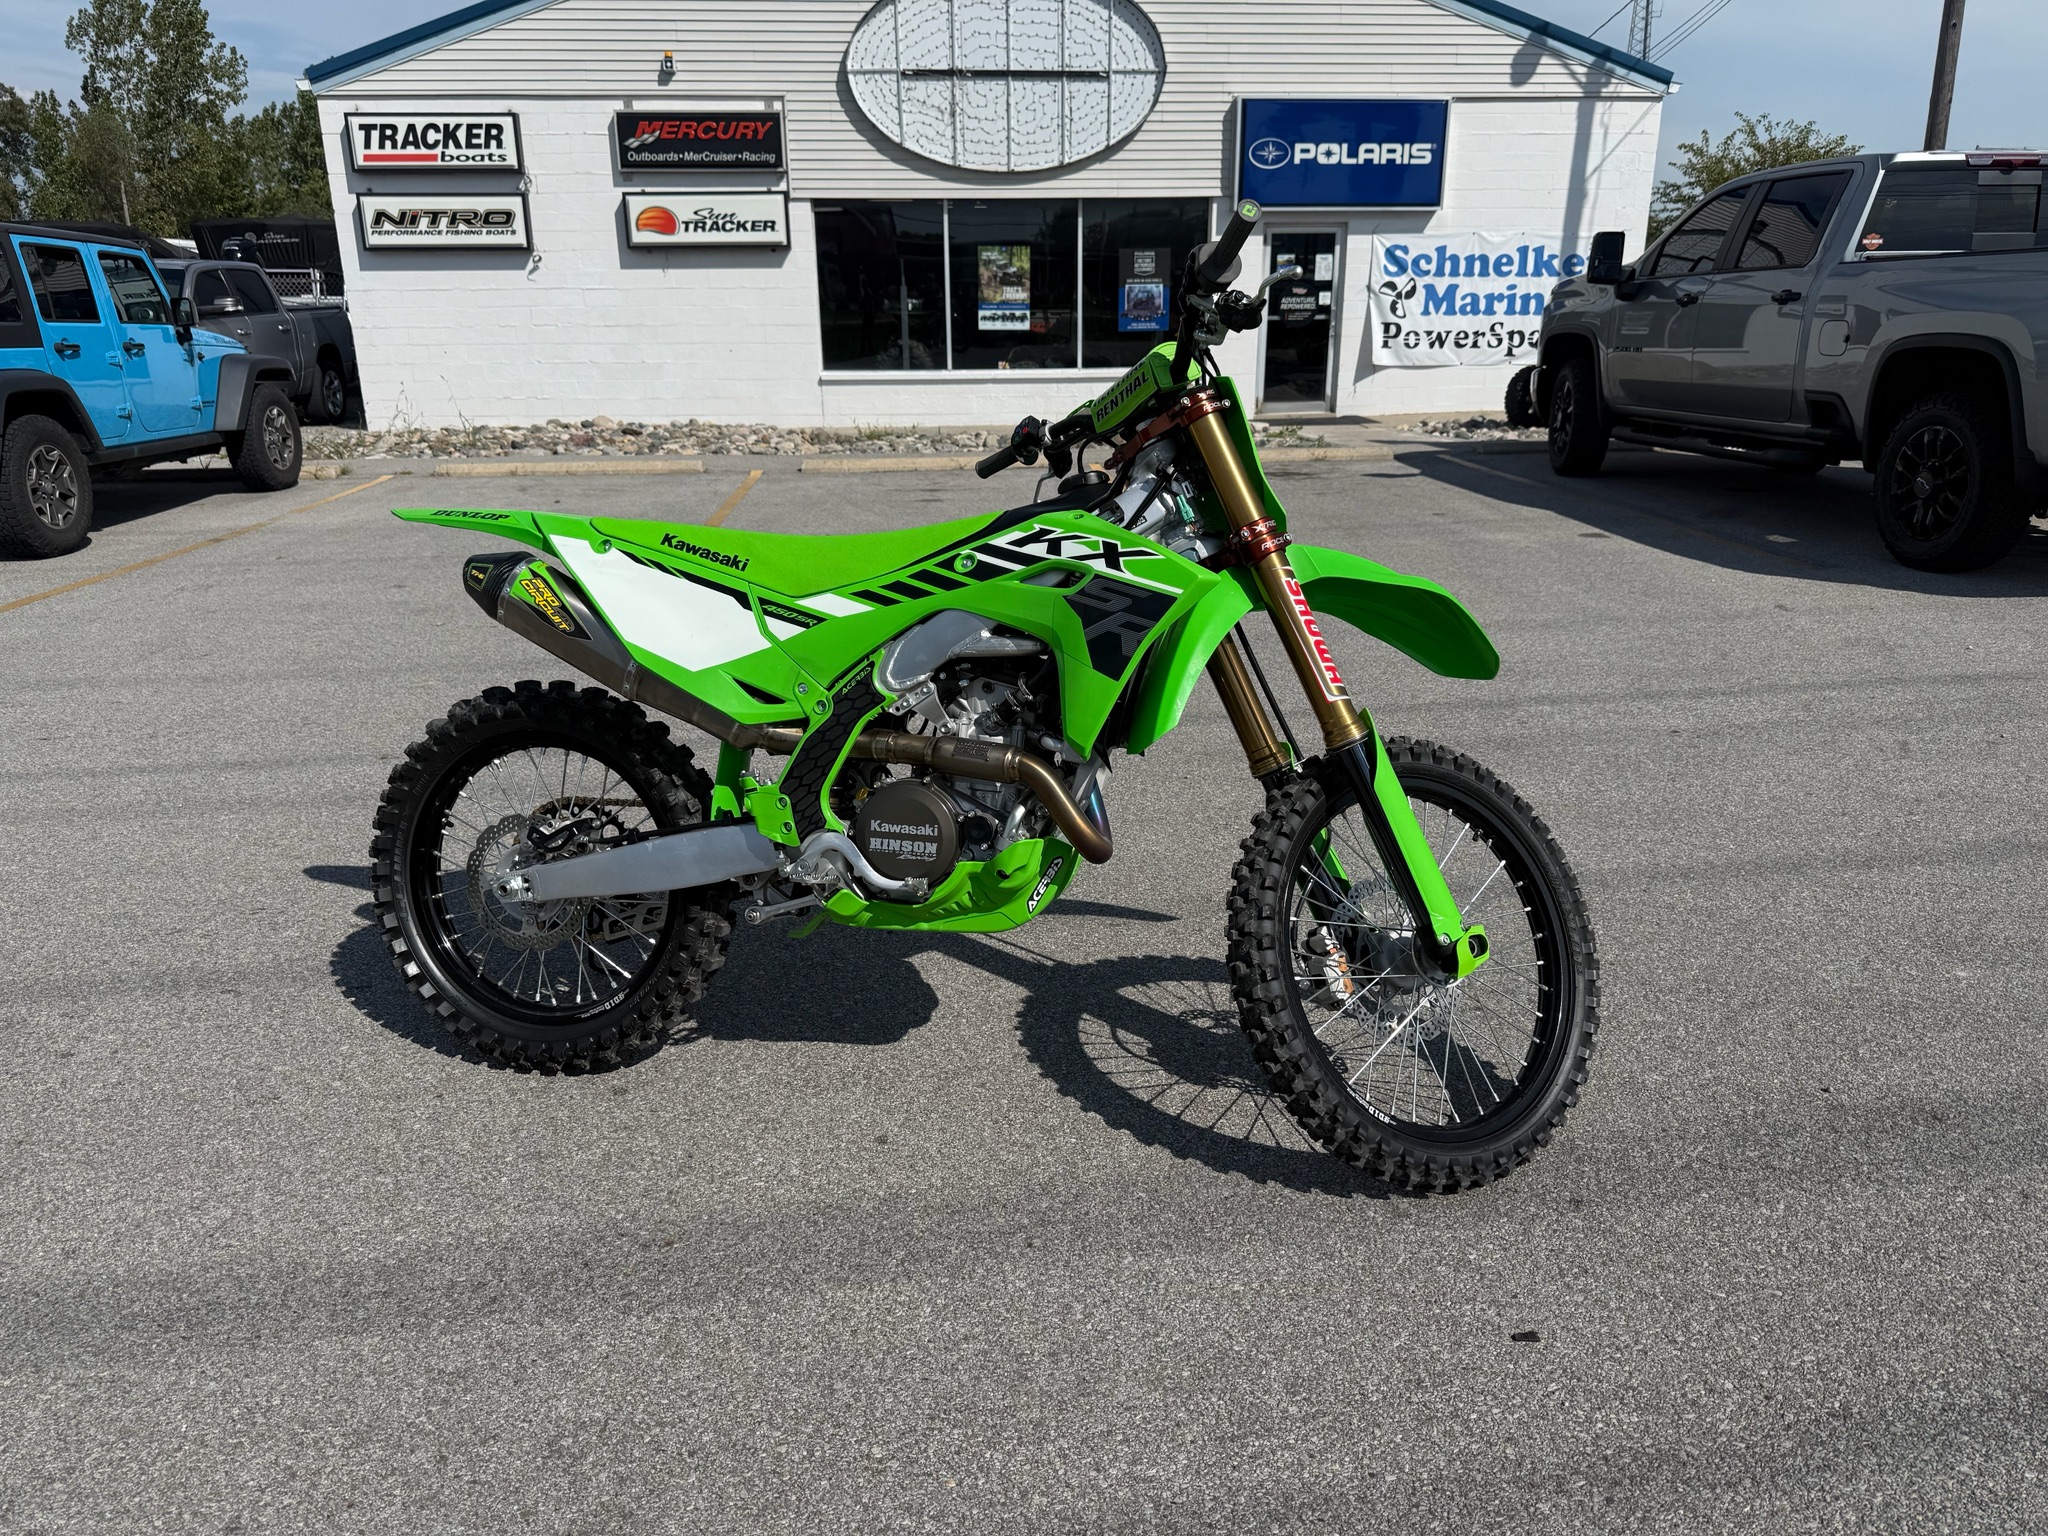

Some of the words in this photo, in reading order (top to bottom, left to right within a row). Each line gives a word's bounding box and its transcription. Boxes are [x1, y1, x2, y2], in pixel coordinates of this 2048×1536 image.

[358, 122, 505, 150] TRACKER
[634, 121, 773, 140] MERCURY
[440, 150, 508, 163] boats
[627, 151, 679, 162] Outboards
[684, 151, 737, 162] MerCruiser
[742, 152, 776, 164] Racing
[1293, 142, 1433, 165] POLARIS
[688, 207, 738, 222] Sun
[681, 220, 777, 233] TRACKER
[1382, 243, 1590, 278] Schnelke
[1096, 371, 1150, 422] RENTHAL
[429, 509, 511, 521] DUNLOP
[660, 533, 751, 573] Kawasaki
[1004, 525, 1164, 575] KX
[531, 578, 561, 608] PRO
[520, 579, 571, 632] CIRCUIT
[1281, 577, 1345, 687] SHOWA
[870, 819, 939, 837] Kawasaki
[869, 837, 938, 854] HINSON
